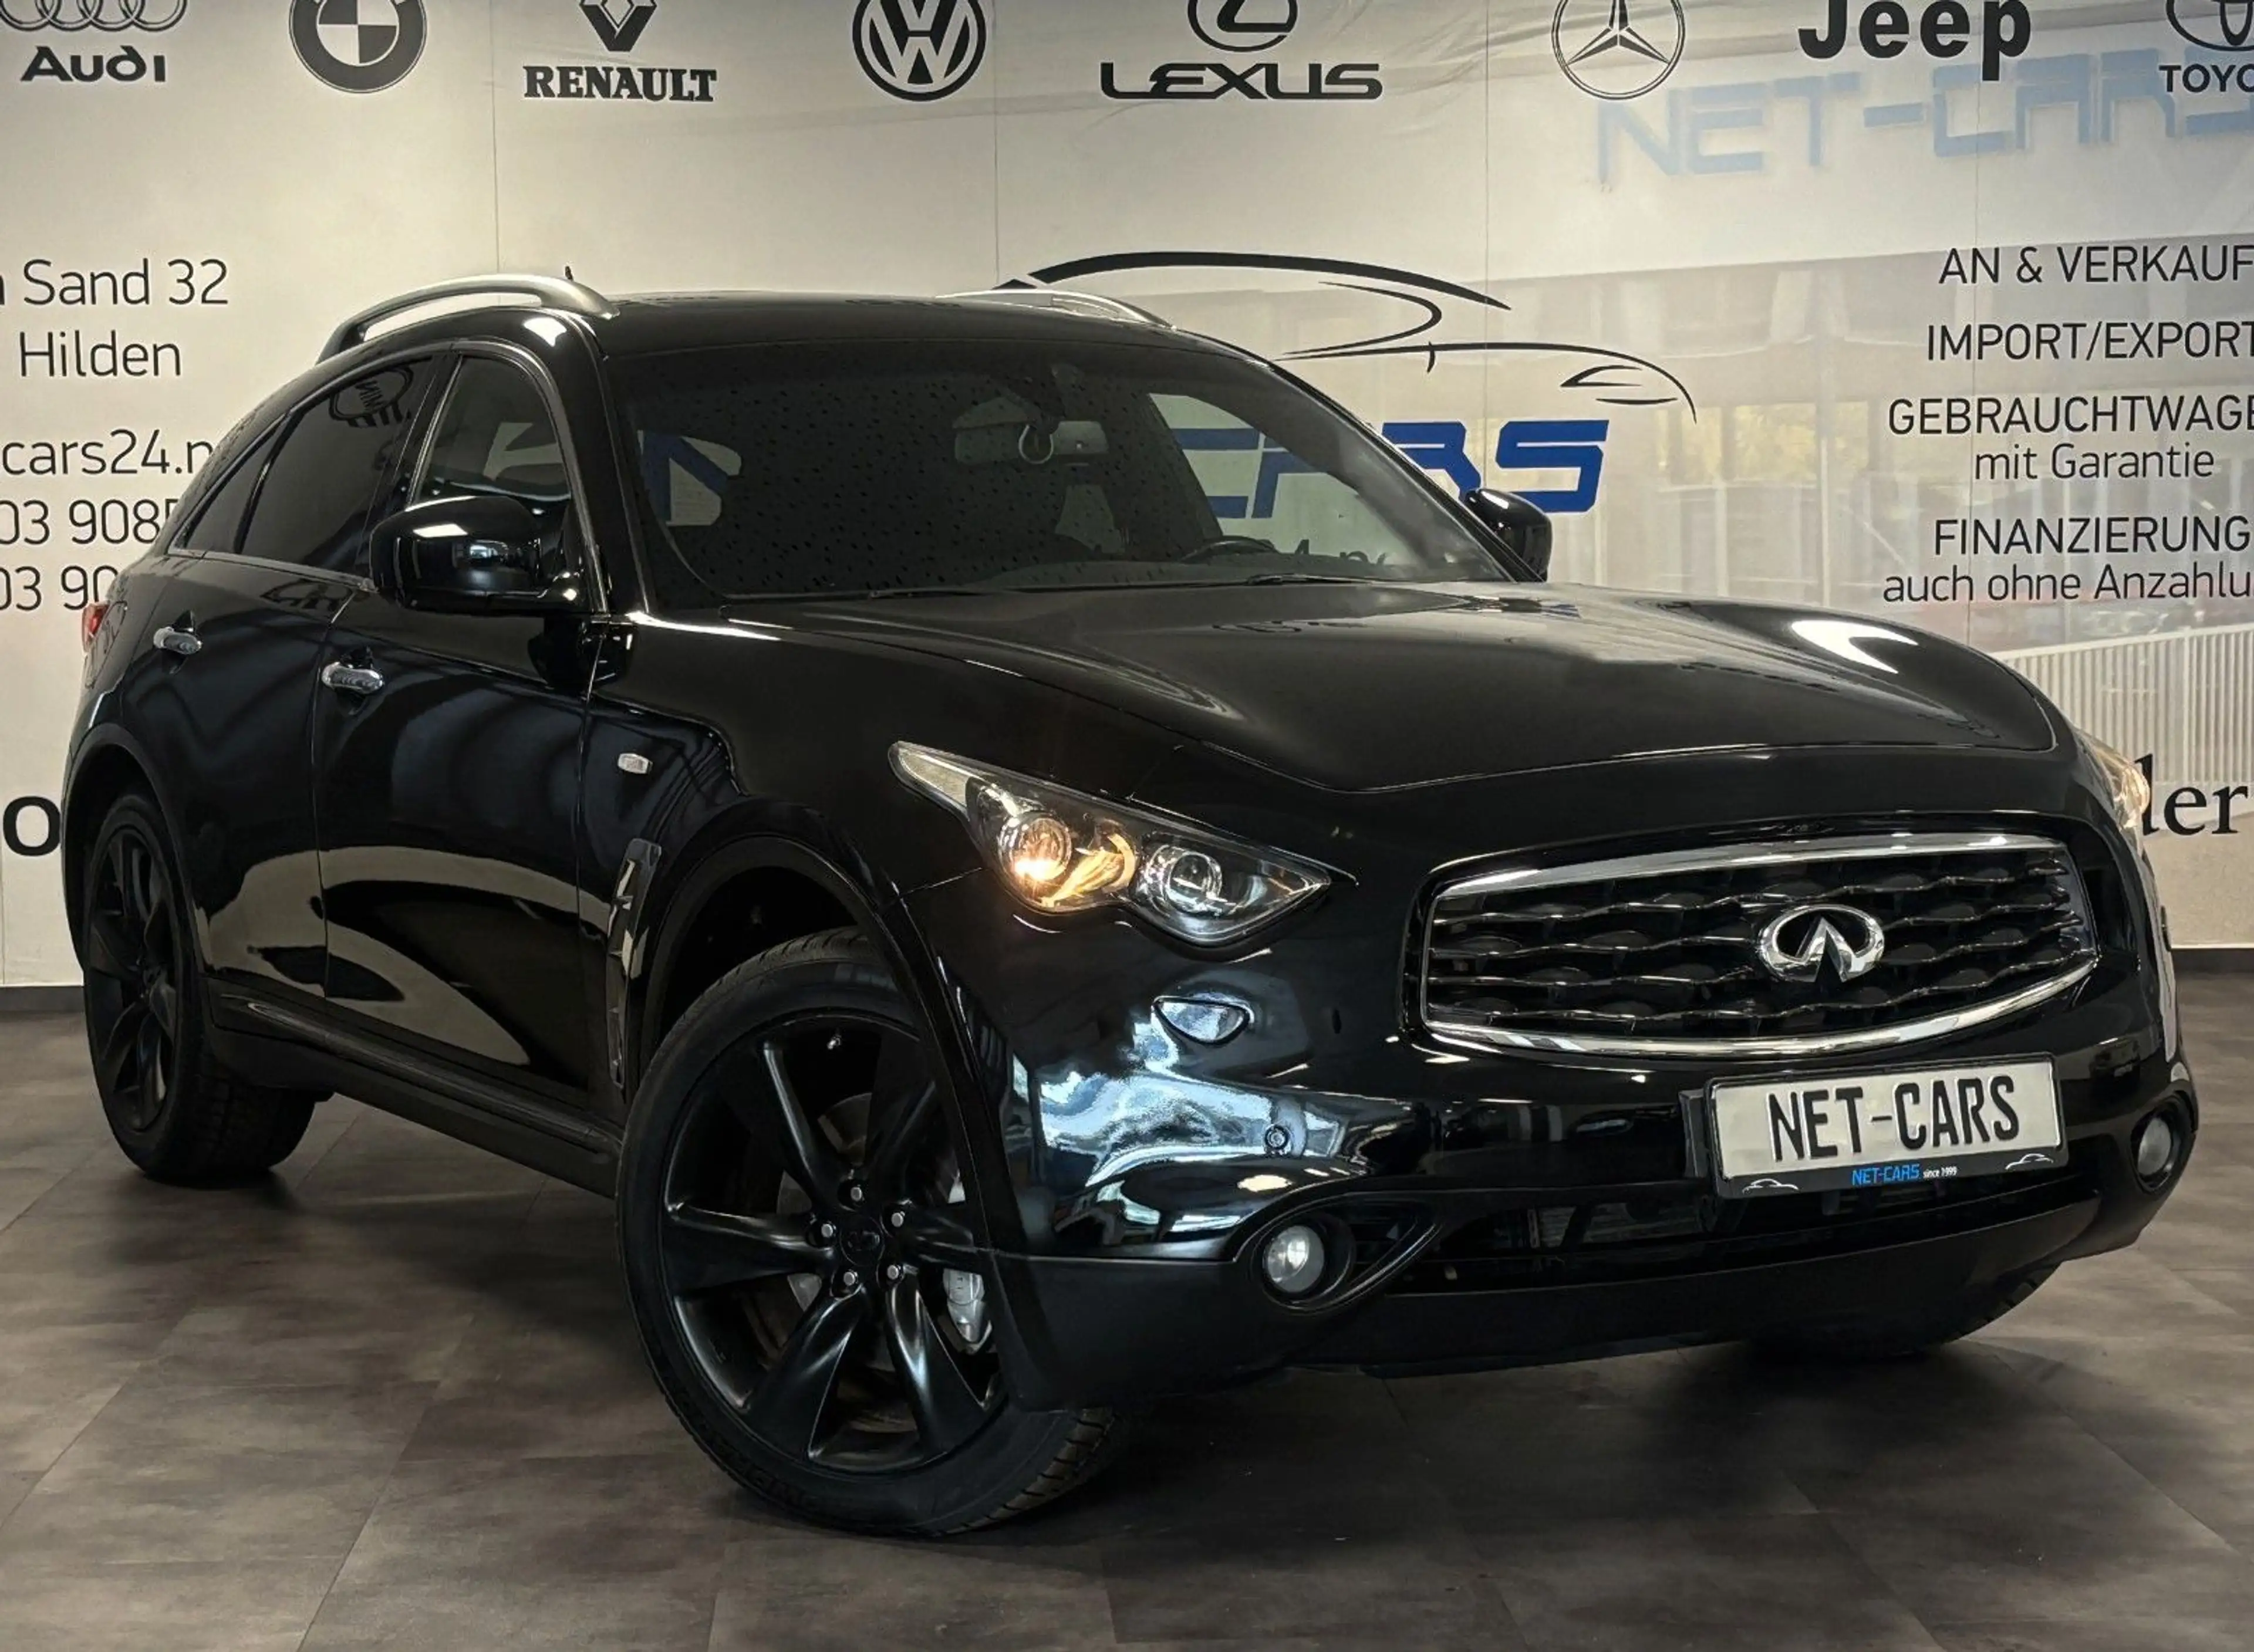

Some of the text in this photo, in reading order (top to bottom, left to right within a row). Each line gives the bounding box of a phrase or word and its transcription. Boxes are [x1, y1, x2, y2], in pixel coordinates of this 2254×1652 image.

[1799, 0, 2030, 81] Jeep
[21, 45, 166, 82] Audi
[1100, 63, 1383, 99] LEXUS
[523, 66, 717, 102] RENAULT
[23, 258, 149, 305] Sand
[168, 259, 228, 305] 32
[1939, 244, 2254, 284] AN & VERKAUF
[20, 330, 180, 377] Hilden
[1976, 442, 2215, 479] mit Garantie
[1935, 515, 2250, 555] FINANZIERUNG
[1883, 560, 2250, 602] auch ohne Anzahlu
[1769, 1076, 2020, 1162] NET-CARS
[1852, 1164, 1920, 1187] NET-CARS
